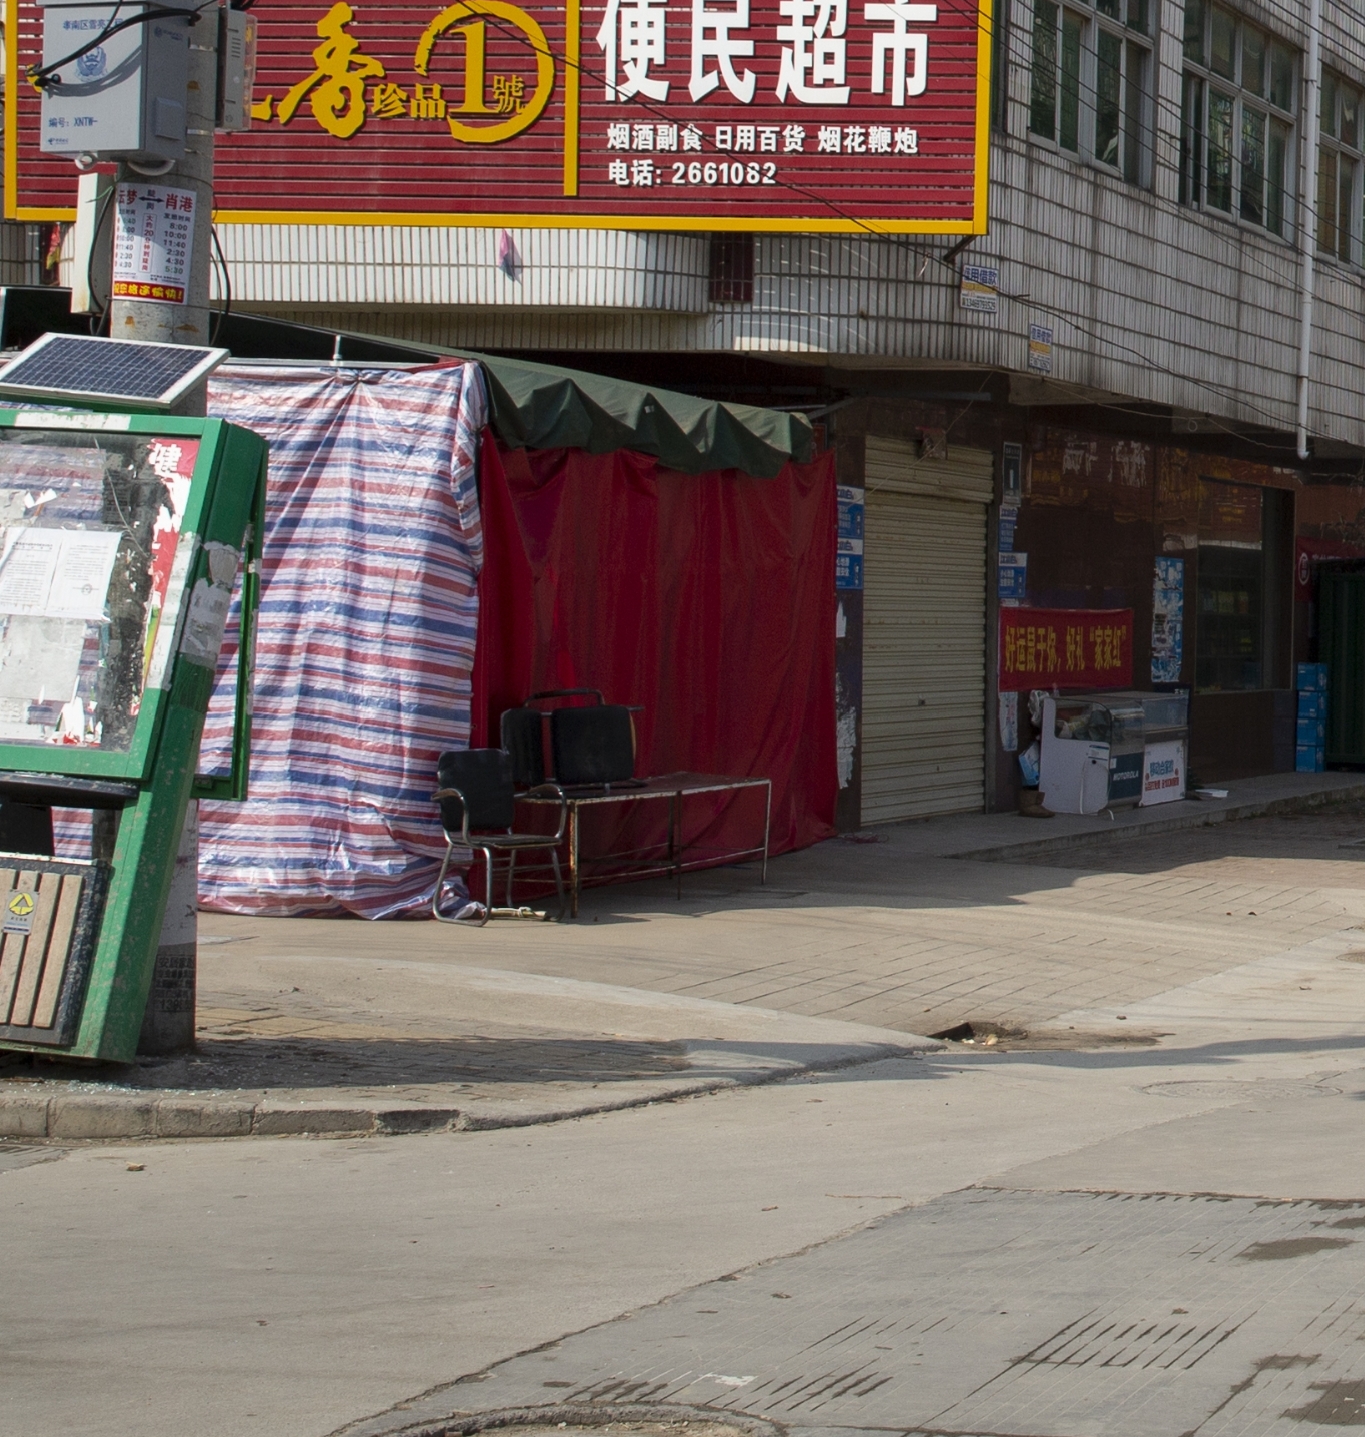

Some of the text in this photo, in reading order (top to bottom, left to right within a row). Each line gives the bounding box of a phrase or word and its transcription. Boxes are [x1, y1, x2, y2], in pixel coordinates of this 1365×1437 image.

[607, 124, 919, 154] 烟酒副食 日用百货 烟花鞭炮
[672, 161, 778, 186] 2661082
[165, 193, 194, 213] 肖港
